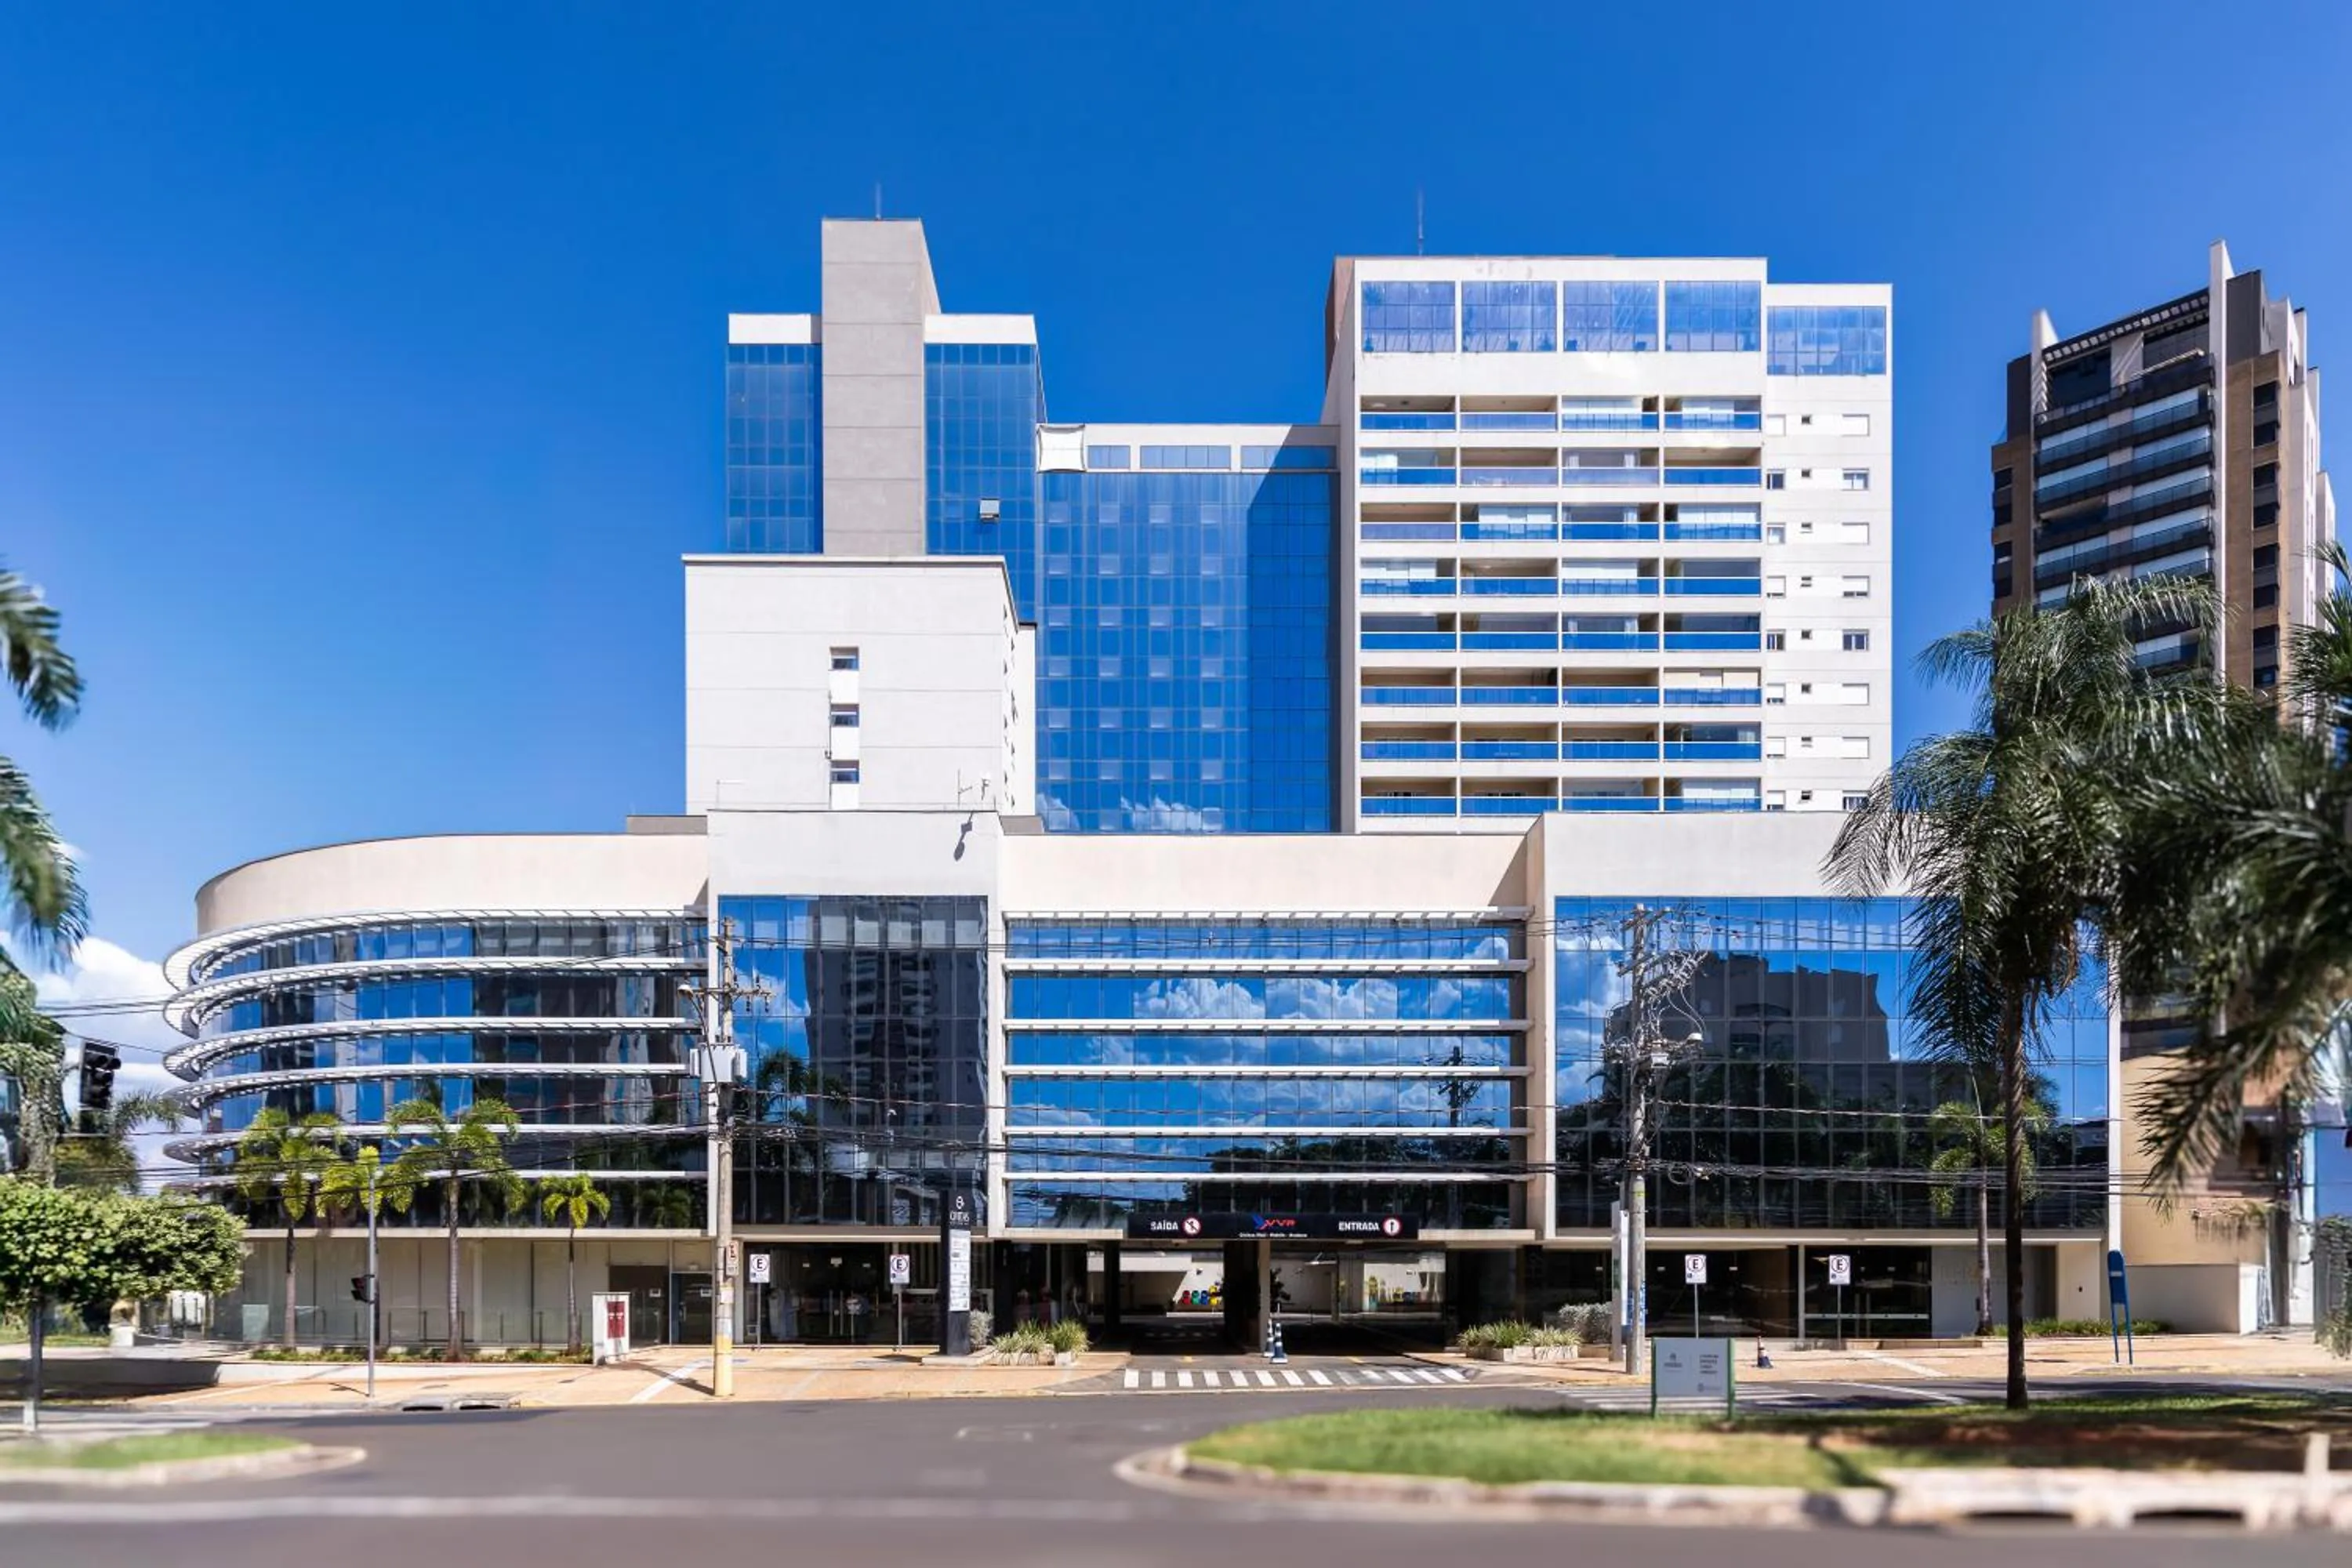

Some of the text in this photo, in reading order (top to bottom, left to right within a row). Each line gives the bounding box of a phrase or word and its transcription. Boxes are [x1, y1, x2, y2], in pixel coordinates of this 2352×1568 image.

[1150, 1220, 1178, 1230] SAÍDA
[1338, 1221, 1380, 1231] ENTRADA
[757, 1259, 763, 1269] E
[896, 1259, 902, 1269] E
[1693, 1259, 1699, 1269] E
[1837, 1259, 1843, 1270] E
